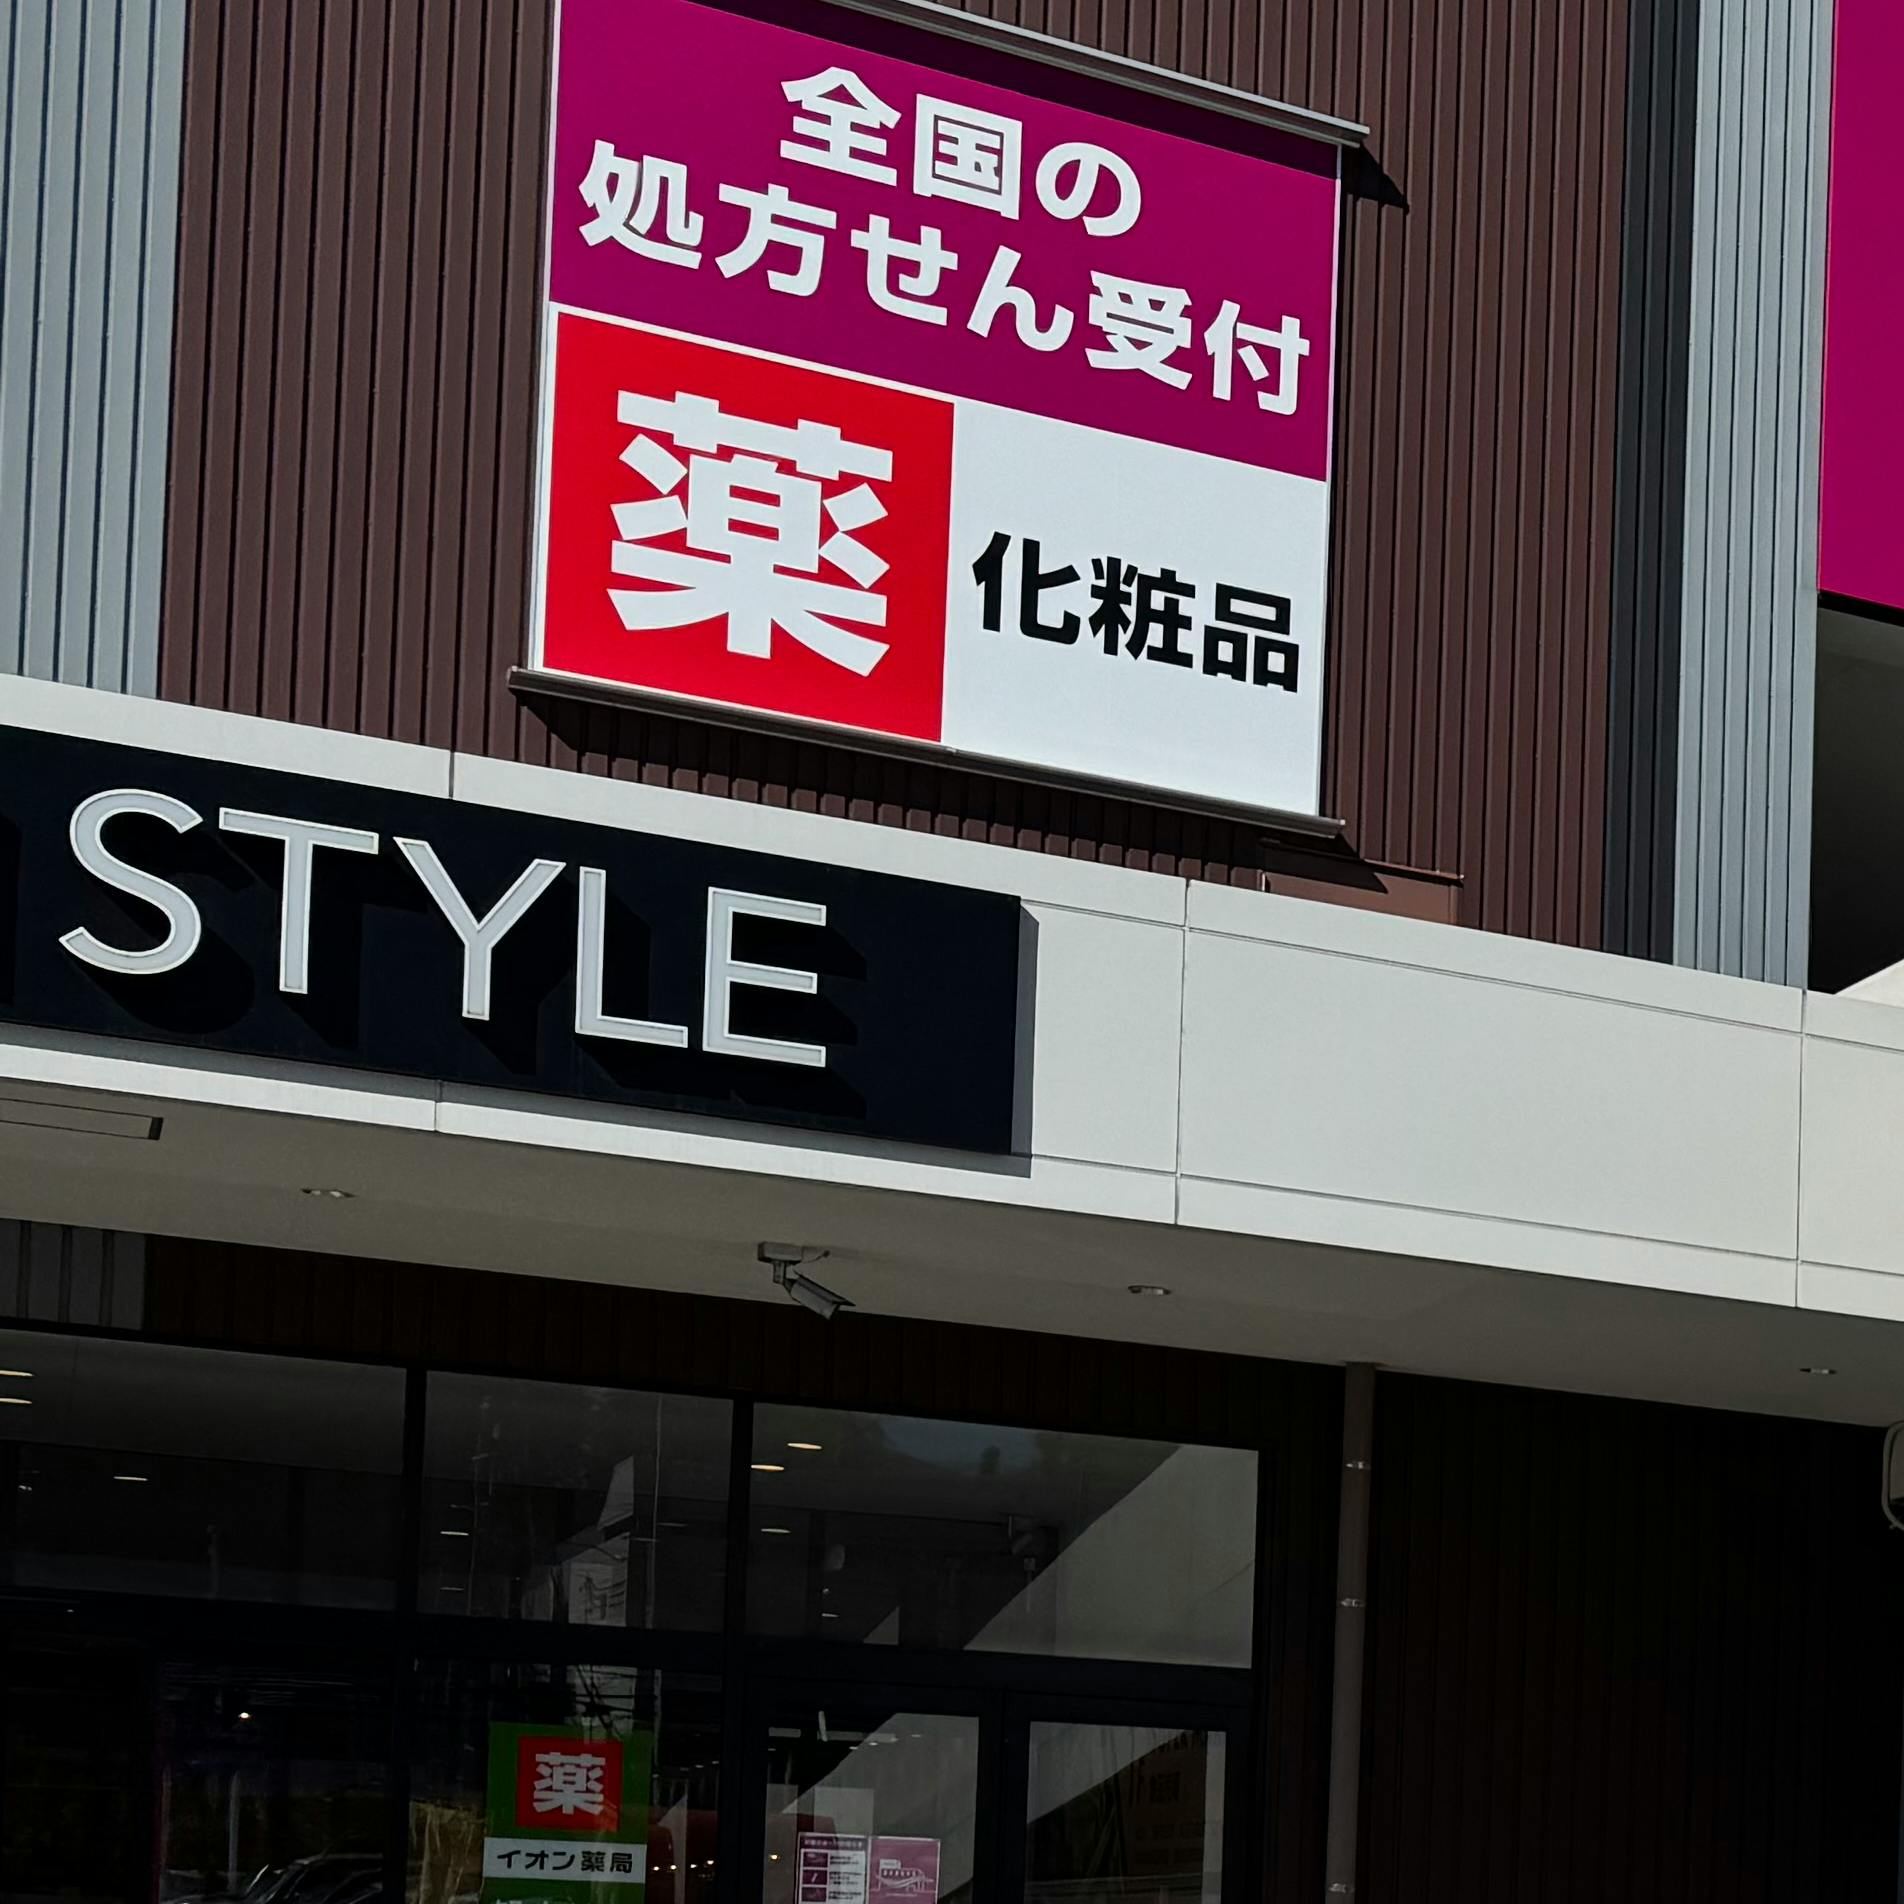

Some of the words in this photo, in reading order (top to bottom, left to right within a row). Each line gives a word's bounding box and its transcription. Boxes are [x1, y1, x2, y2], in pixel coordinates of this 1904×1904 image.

[780, 65, 1142, 239] 全国の
[577, 139, 1311, 417] 処方せん受付
[606, 388, 894, 679] 薬
[971, 531, 1302, 696] 化粧品
[57, 787, 829, 1070] STYLE
[495, 1848, 634, 1876] イオン薬局
[532, 1751, 607, 1816] 薬
